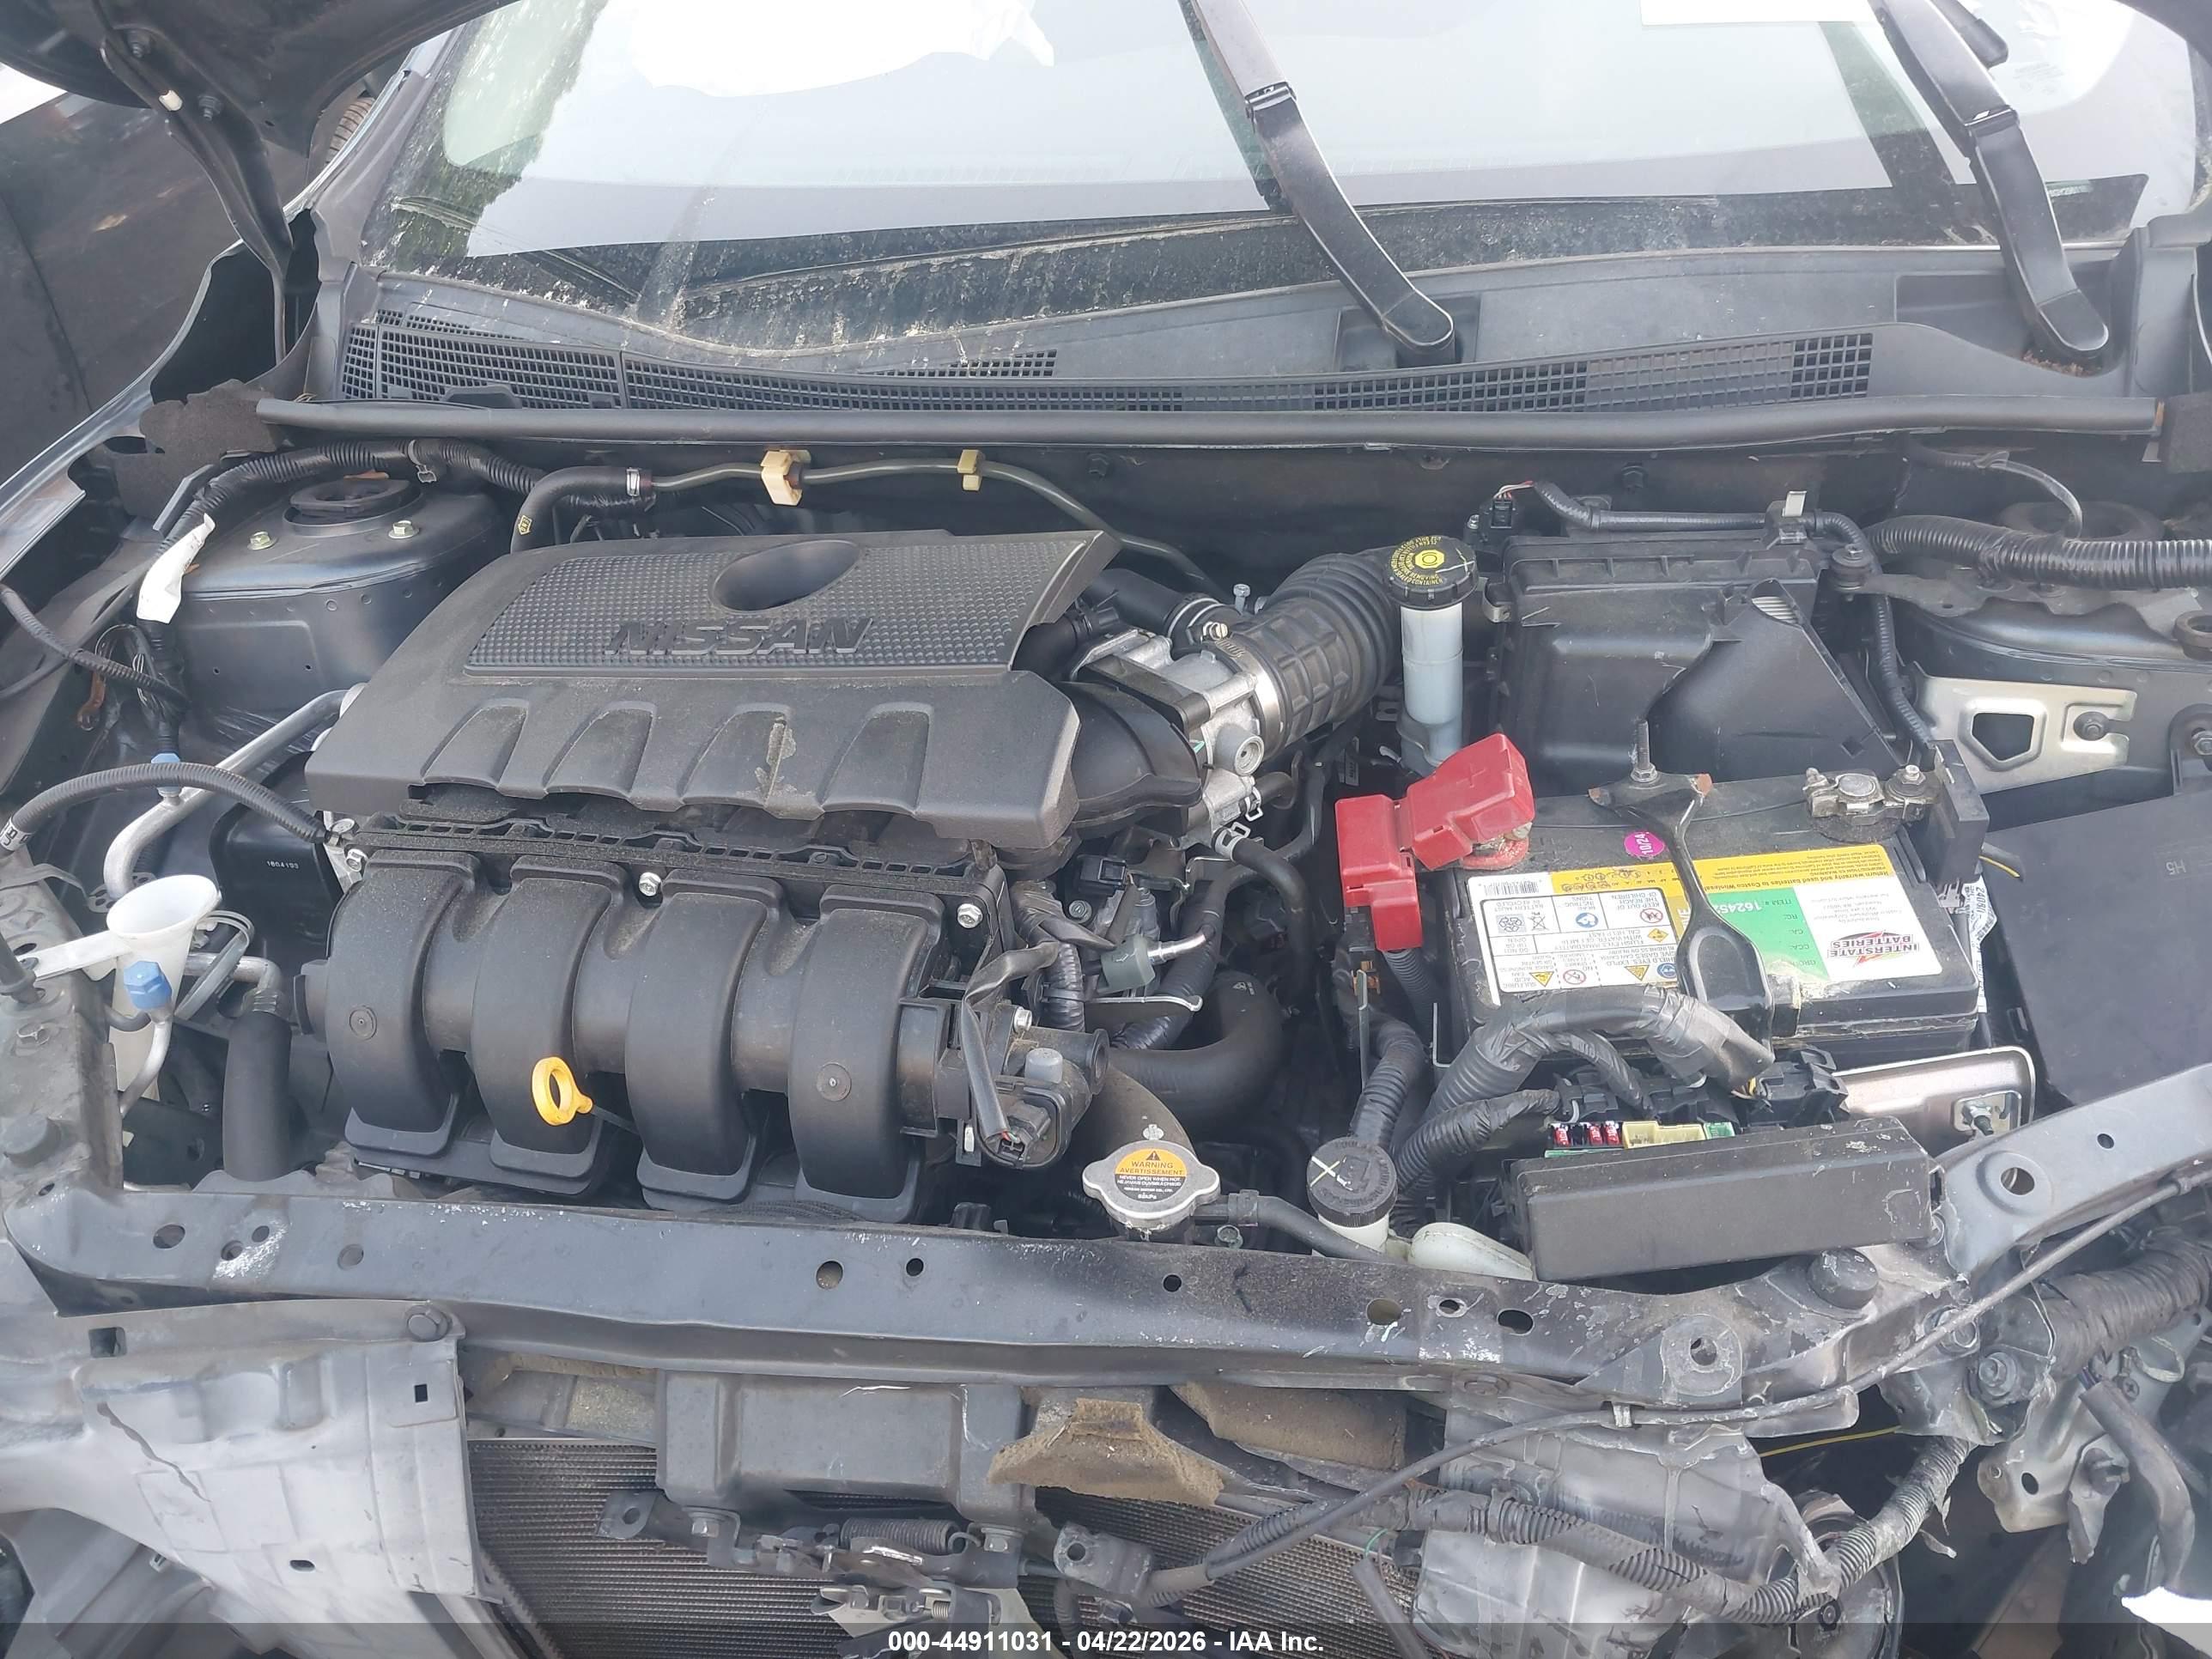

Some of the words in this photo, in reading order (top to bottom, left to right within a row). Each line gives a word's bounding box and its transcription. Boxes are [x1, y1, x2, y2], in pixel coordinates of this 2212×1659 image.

[604, 617, 873, 655] NISSAN
[1634, 834, 1654, 854] 10/24
[1834, 872, 1864, 880] warranty
[1704, 884, 1735, 892] Wholesal
[1832, 935, 1911, 950] BATTERIES
[1829, 944, 1918, 958] INTERSTATE
[1131, 1160, 1174, 1169] WARNING
[1119, 1167, 1183, 1176] AVERTISSEMENT
